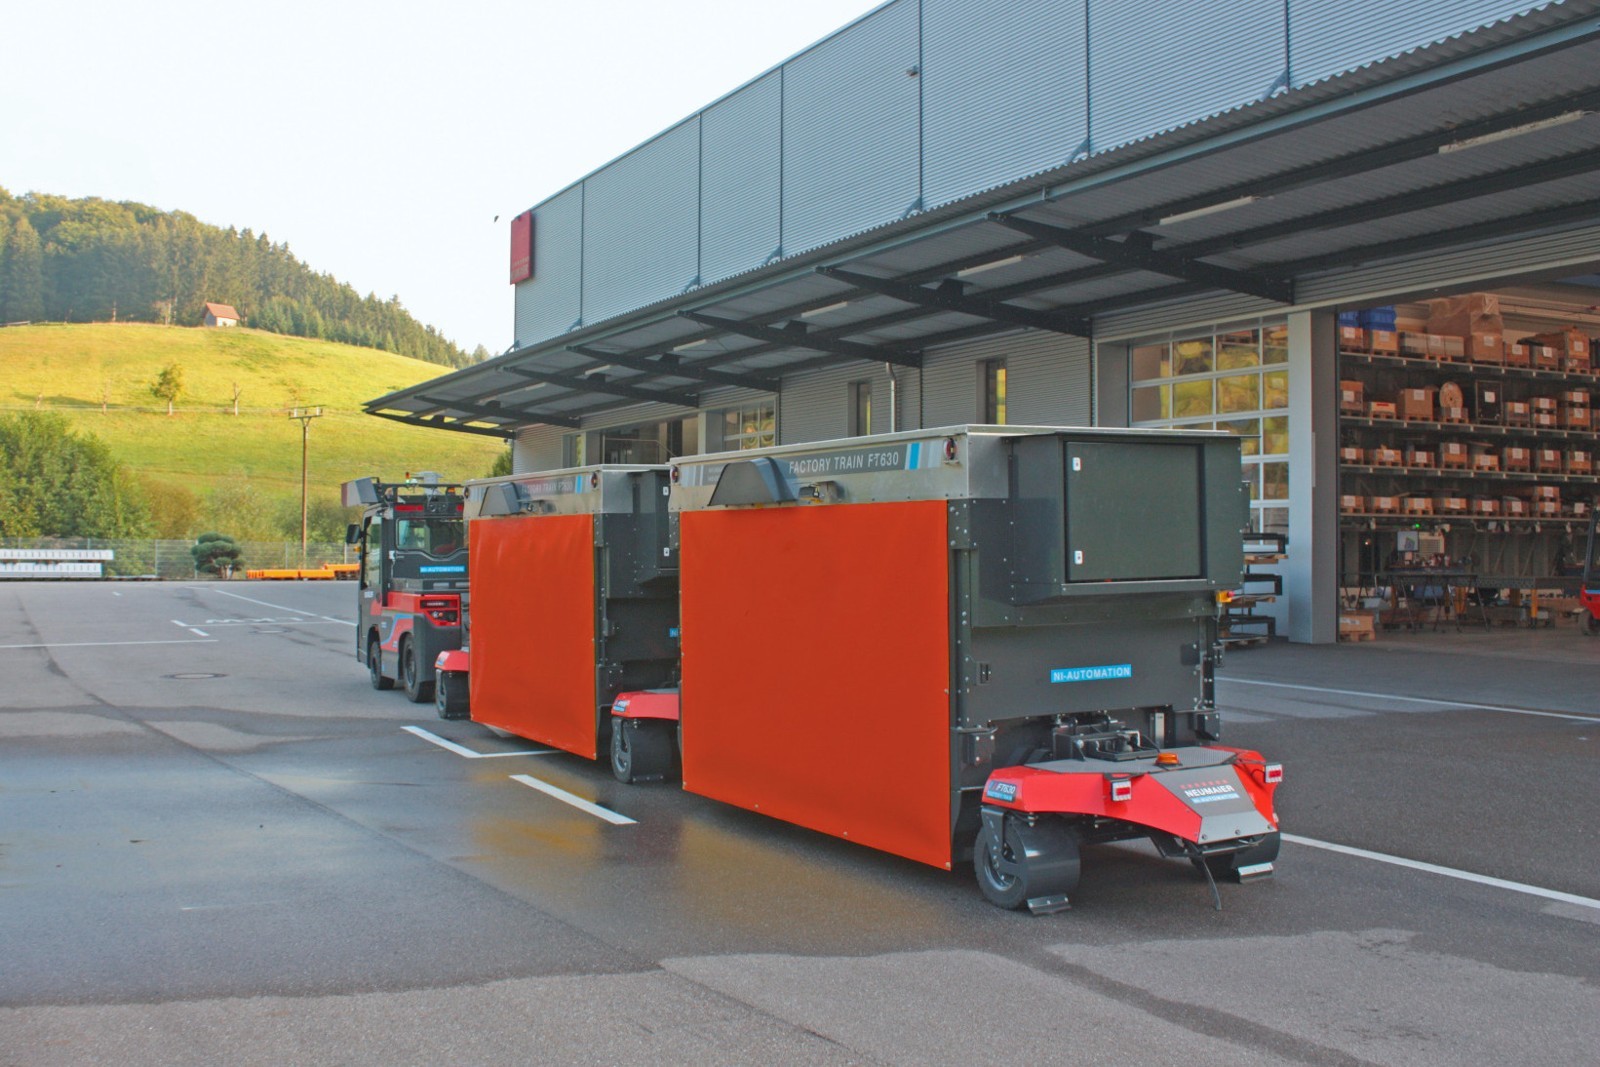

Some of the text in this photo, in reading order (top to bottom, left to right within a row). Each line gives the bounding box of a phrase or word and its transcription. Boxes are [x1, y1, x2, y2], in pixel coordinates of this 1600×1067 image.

[789, 451, 899, 475] FACTORY TRAIN FT630
[1053, 667, 1130, 681] NI-AUTOMATION
[1184, 784, 1235, 798] NEUMAIER
